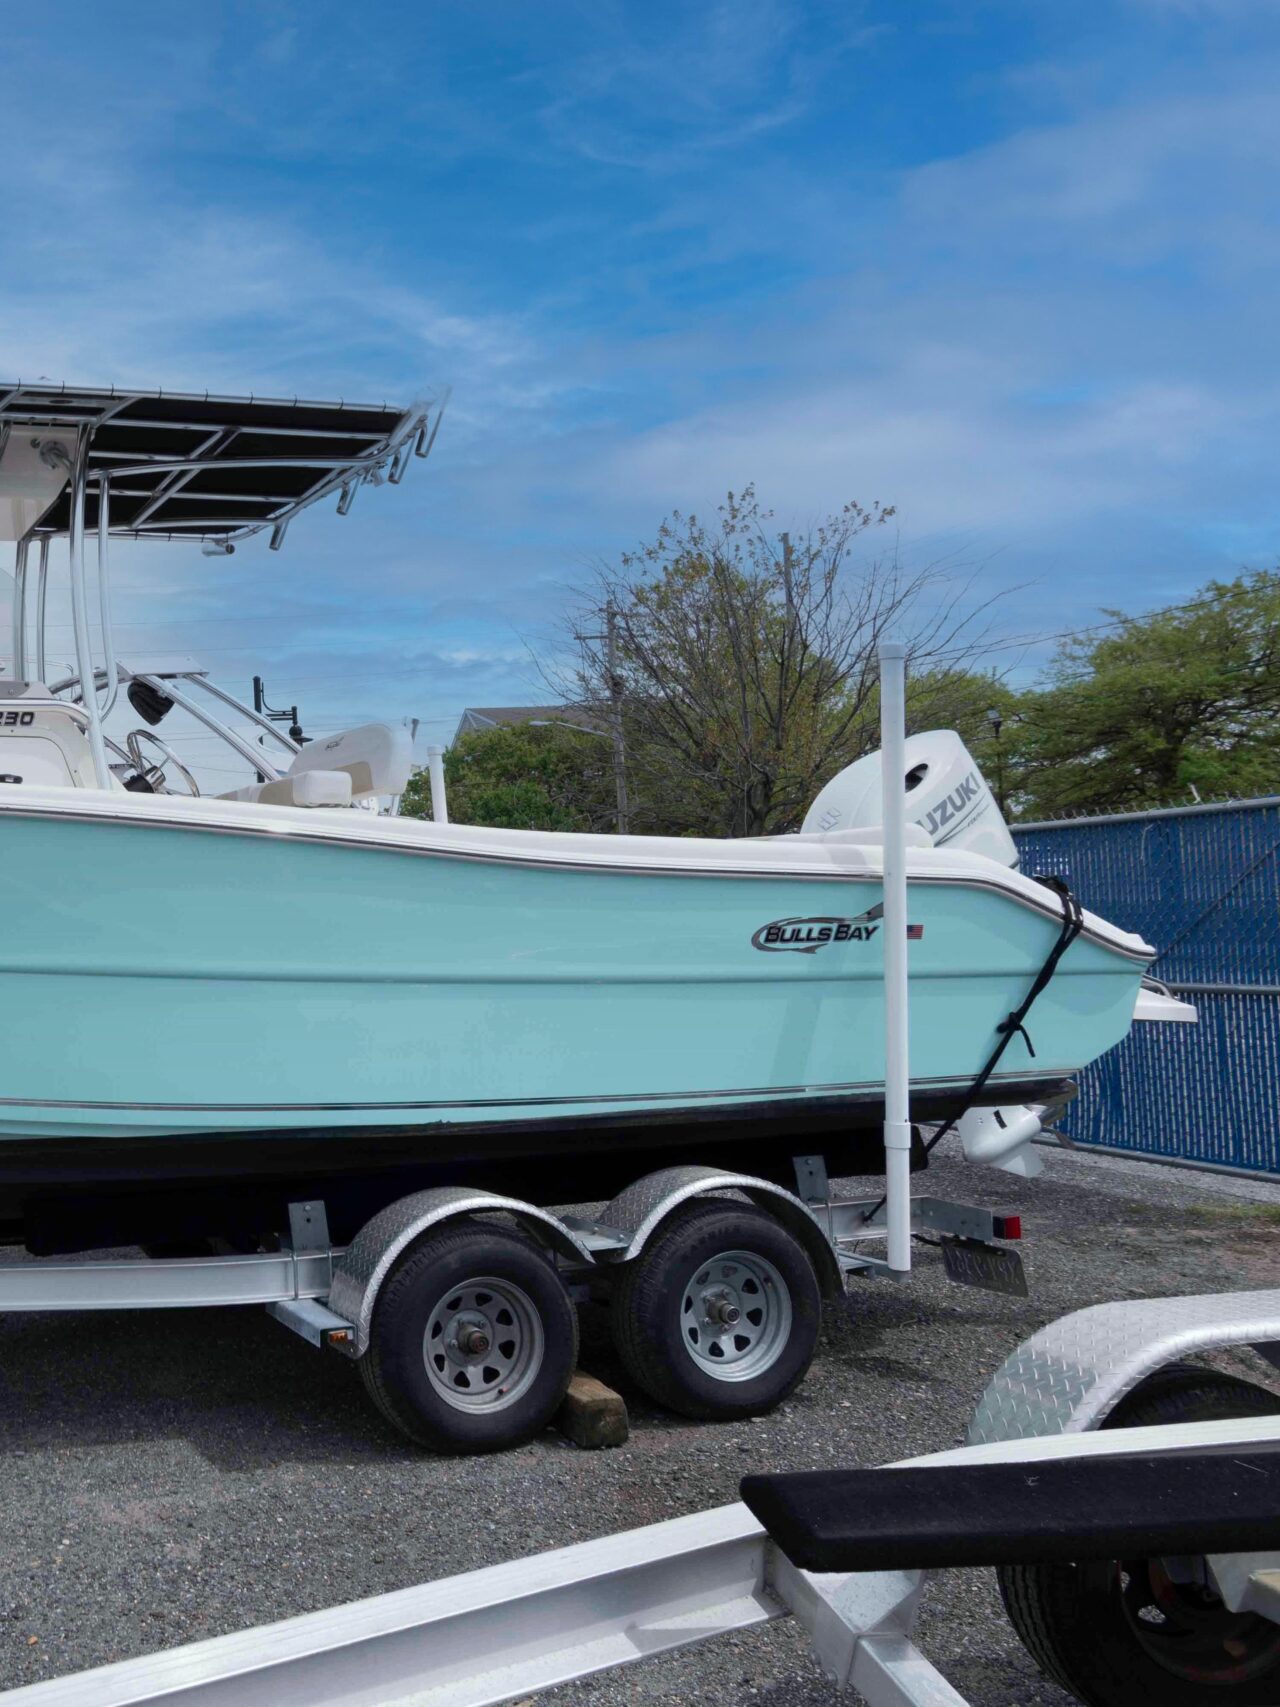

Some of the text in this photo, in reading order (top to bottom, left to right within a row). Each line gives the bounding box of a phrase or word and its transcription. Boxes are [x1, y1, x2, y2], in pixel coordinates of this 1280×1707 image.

[915, 771, 982, 836] UZUKI
[763, 924, 880, 945] BULLS BAY
